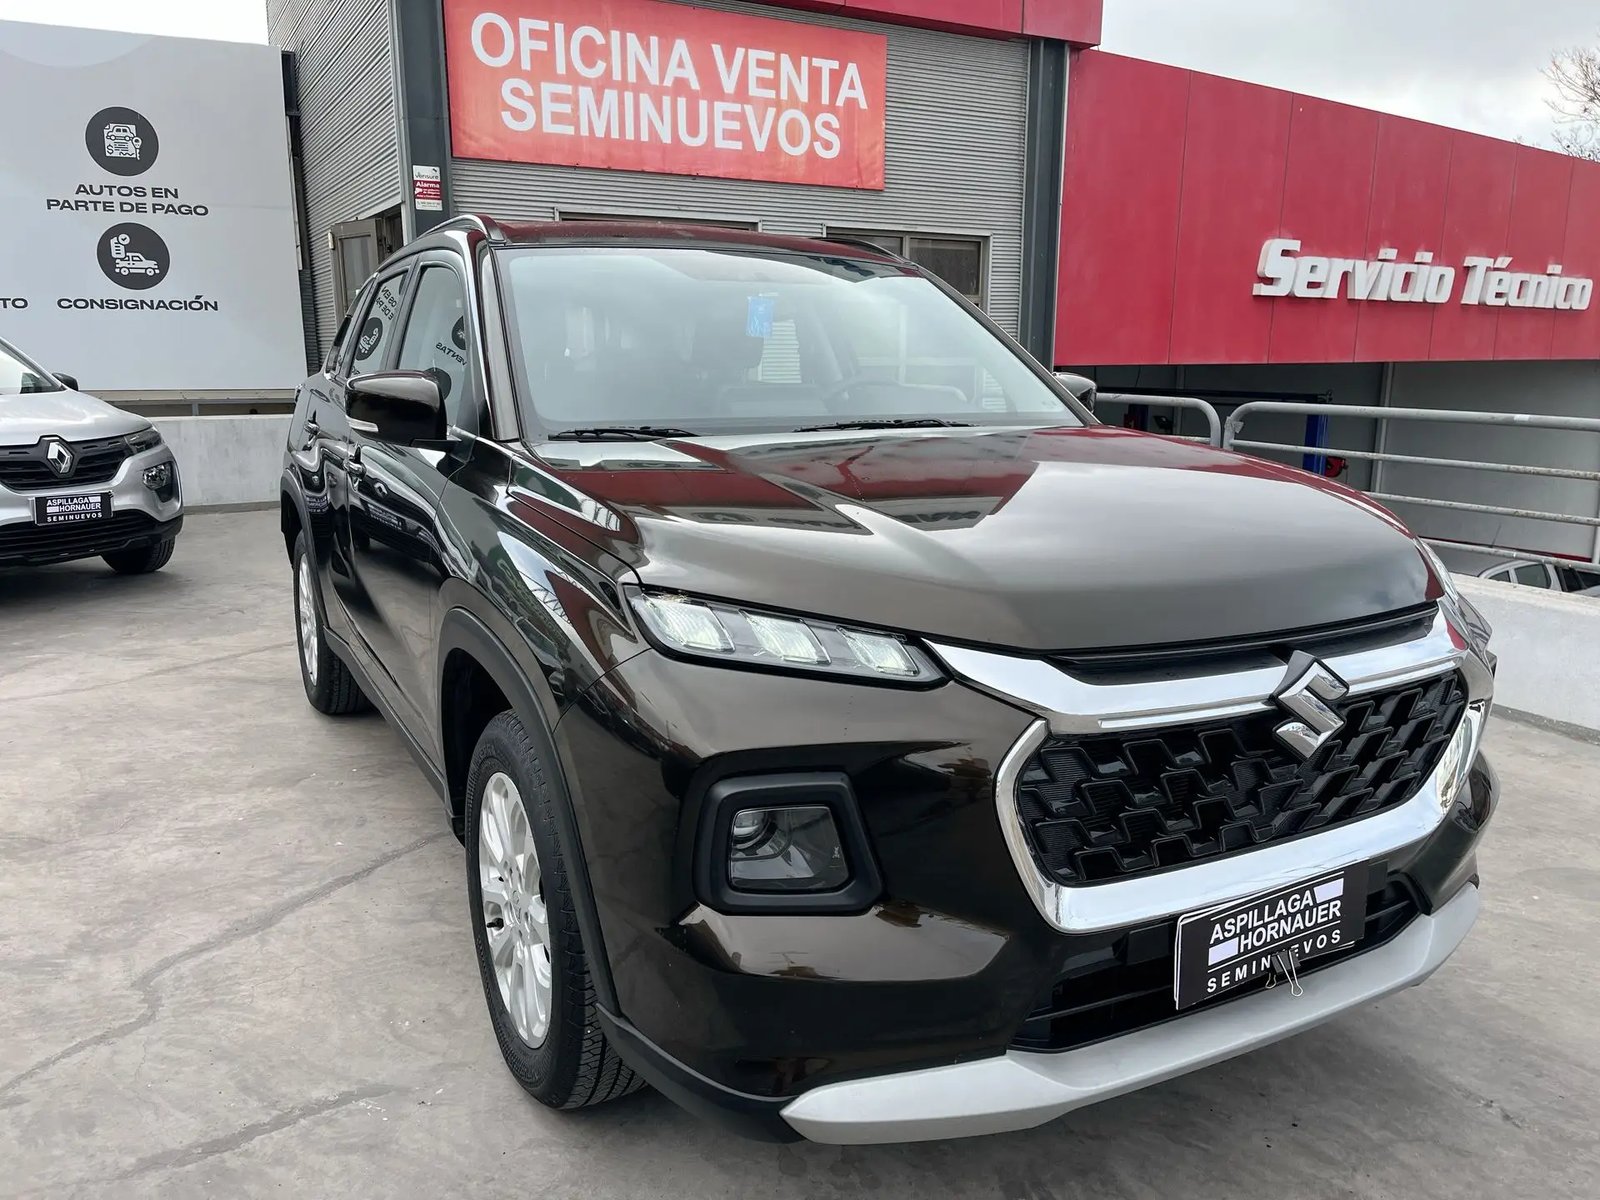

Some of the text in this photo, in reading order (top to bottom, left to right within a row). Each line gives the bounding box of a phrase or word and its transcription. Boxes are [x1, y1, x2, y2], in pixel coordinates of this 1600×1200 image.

[471, 12, 868, 110] OFICINA VENTA
[501, 78, 841, 159] SEMINUEVOS
[75, 184, 178, 199] AUTOS EN
[46, 199, 209, 216] PARTE DE PAGO
[1252, 238, 1594, 310] Servicio Técnico
[57, 295, 218, 311] CONSIGNACIÓN
[47, 497, 89, 506] ASPILLAGA
[60, 503, 101, 512] HORNAUER
[47, 512, 102, 522] SEMINUEVOS
[1210, 890, 1313, 944] ASPILLAGA
[1240, 900, 1341, 952] HORNAUER
